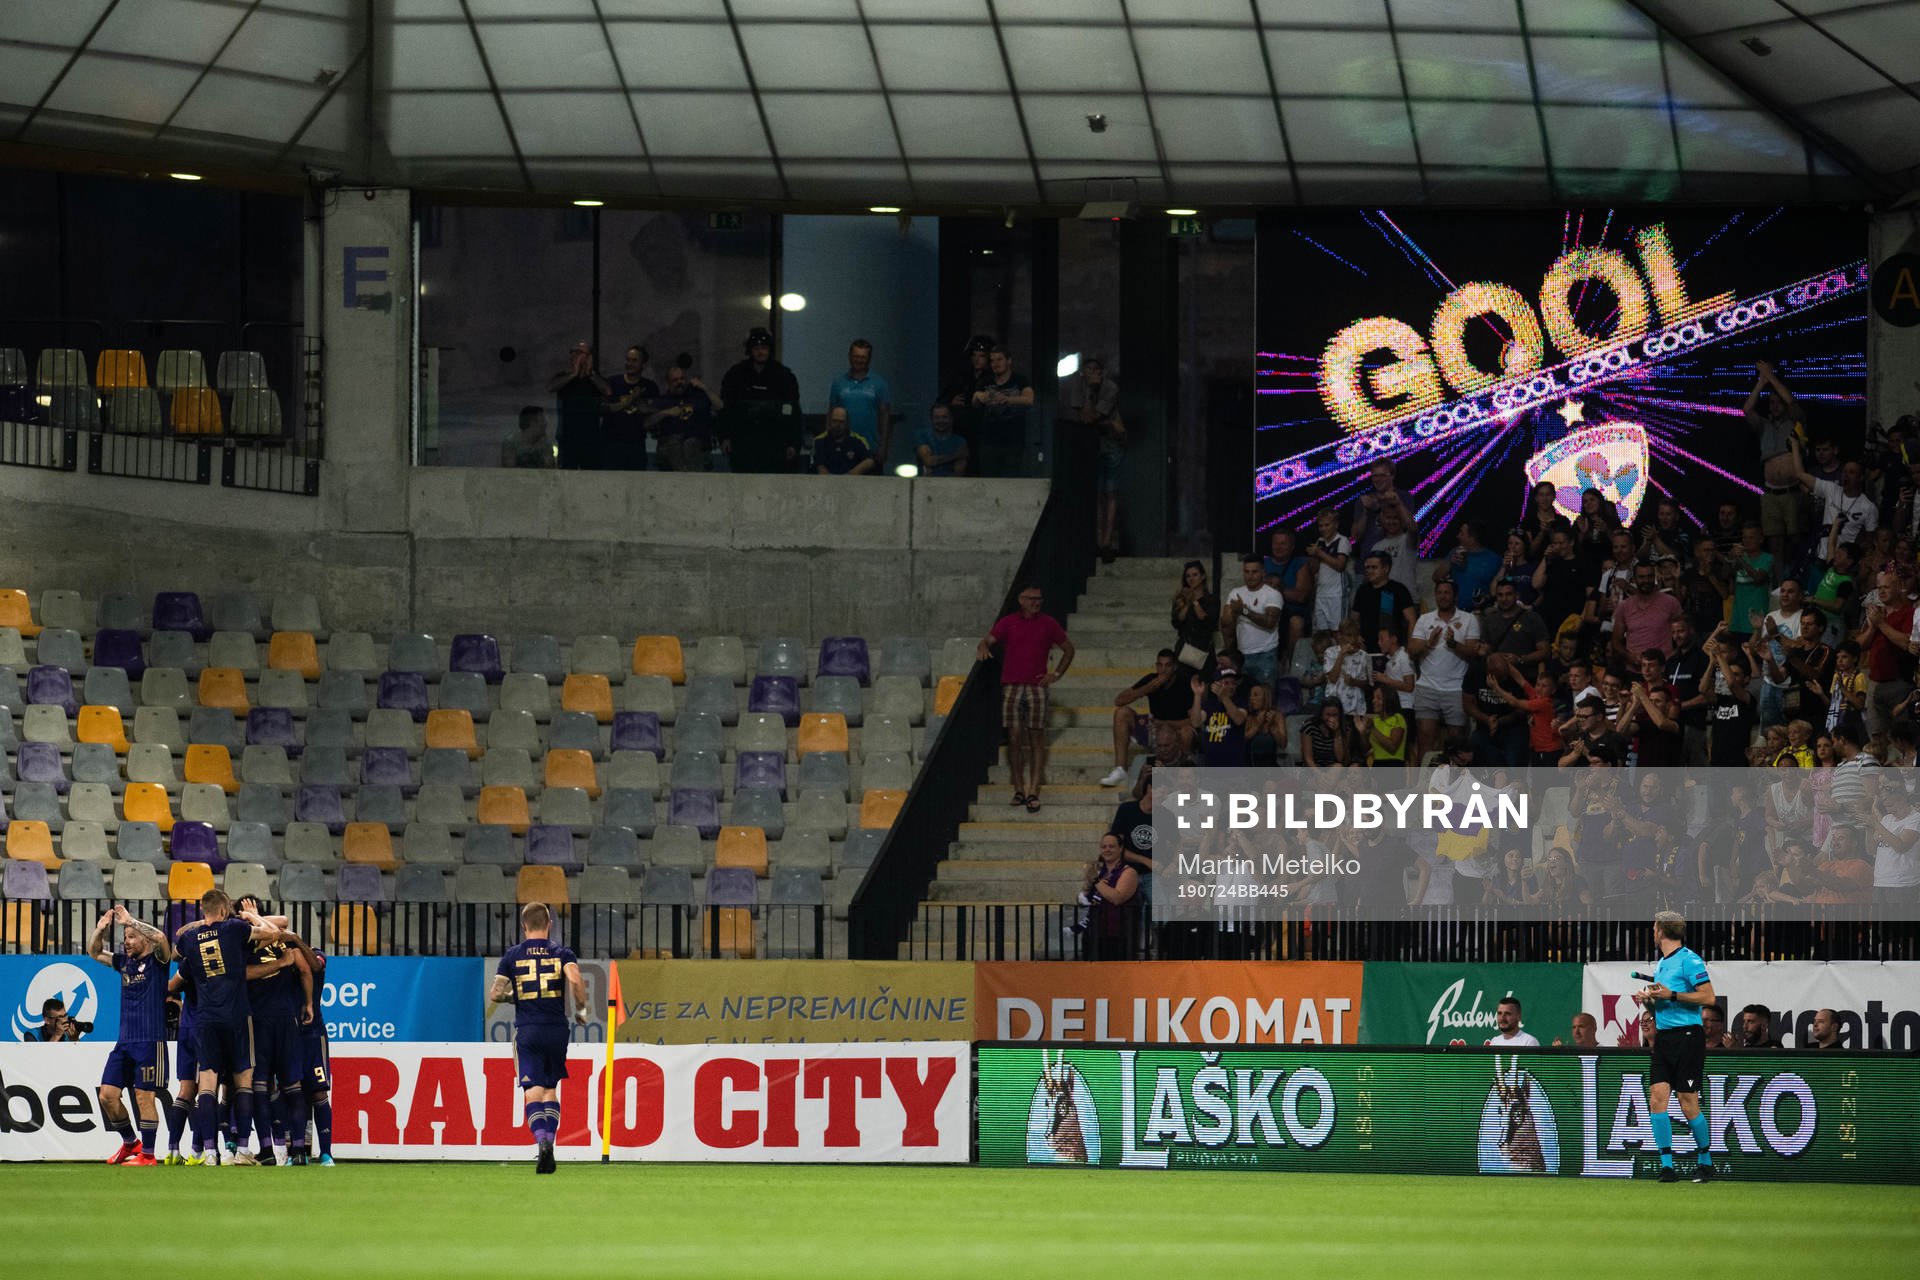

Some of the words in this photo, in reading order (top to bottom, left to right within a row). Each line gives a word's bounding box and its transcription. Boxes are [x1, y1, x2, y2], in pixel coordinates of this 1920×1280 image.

[1888, 267, 1920, 310] A
[1317, 222, 1736, 435] GOOL
[1415, 401, 1487, 436] GOOL
[1493, 372, 1565, 408] GOOL
[1568, 347, 1640, 383] GOOL
[1643, 322, 1714, 357] GOOL
[1716, 296, 1784, 331] GOOL
[199, 938, 226, 978] 8
[515, 957, 562, 1001] 22
[624, 1002, 667, 1020] VSE
[676, 1002, 711, 1020] ZA
[721, 985, 968, 1022] NEPREMIČNINE
[996, 996, 1351, 1045] DELIKOMAT
[325, 1017, 396, 1039] ervice
[139, 1065, 156, 1083] 10
[314, 1066, 326, 1083] 9
[694, 1056, 957, 1149] CITY
[1119, 1050, 1336, 1168] LAŠKO
